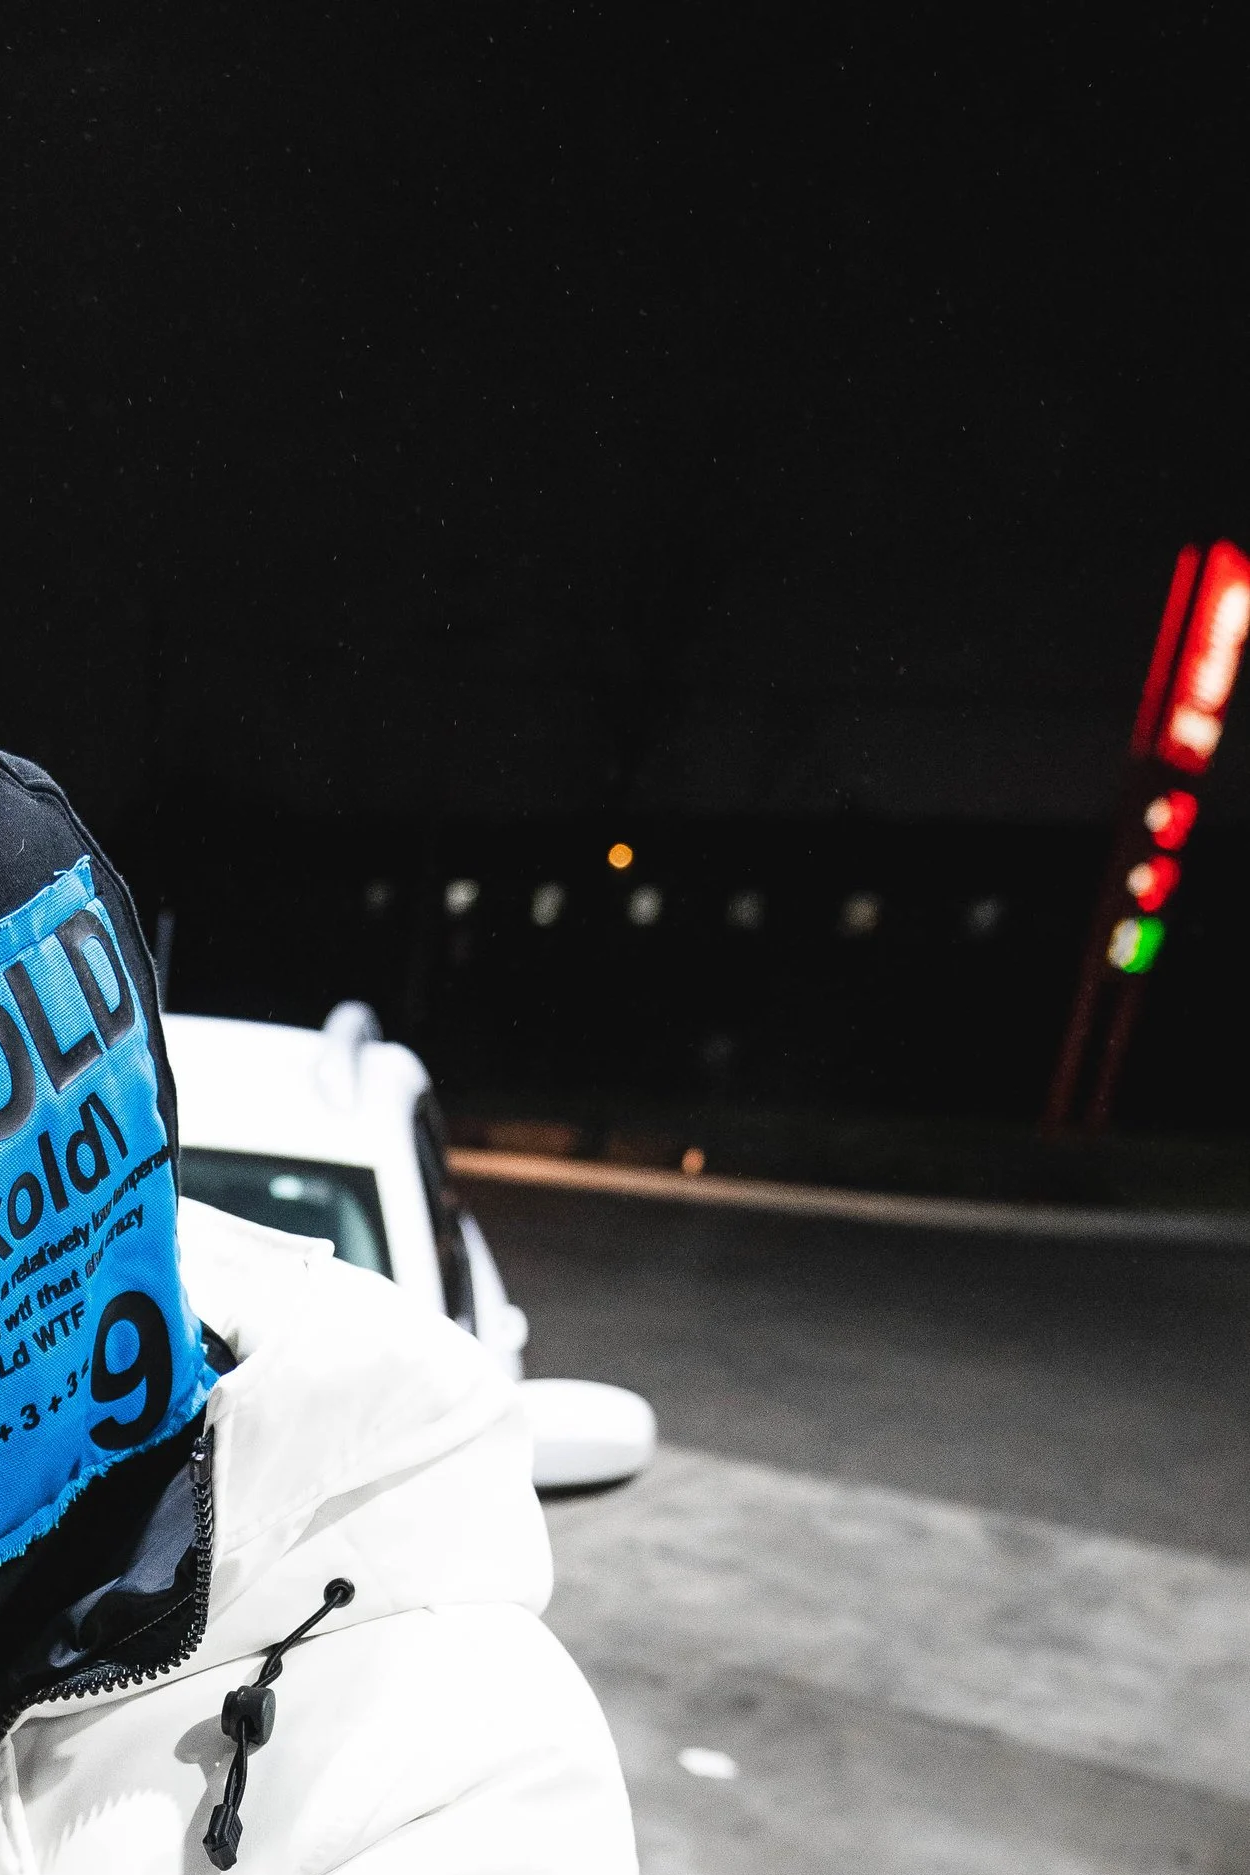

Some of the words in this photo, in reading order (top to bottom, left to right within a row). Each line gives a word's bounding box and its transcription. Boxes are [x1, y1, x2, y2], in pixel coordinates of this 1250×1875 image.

[11, 1223, 90, 1288] relatively
[4, 1294, 34, 1332] wtf
[37, 1269, 81, 1309] that
[32, 1300, 85, 1353] WTF
[20, 1403, 41, 1431] 3
[66, 1371, 78, 1398] 3
[89, 1290, 173, 1450] 9
